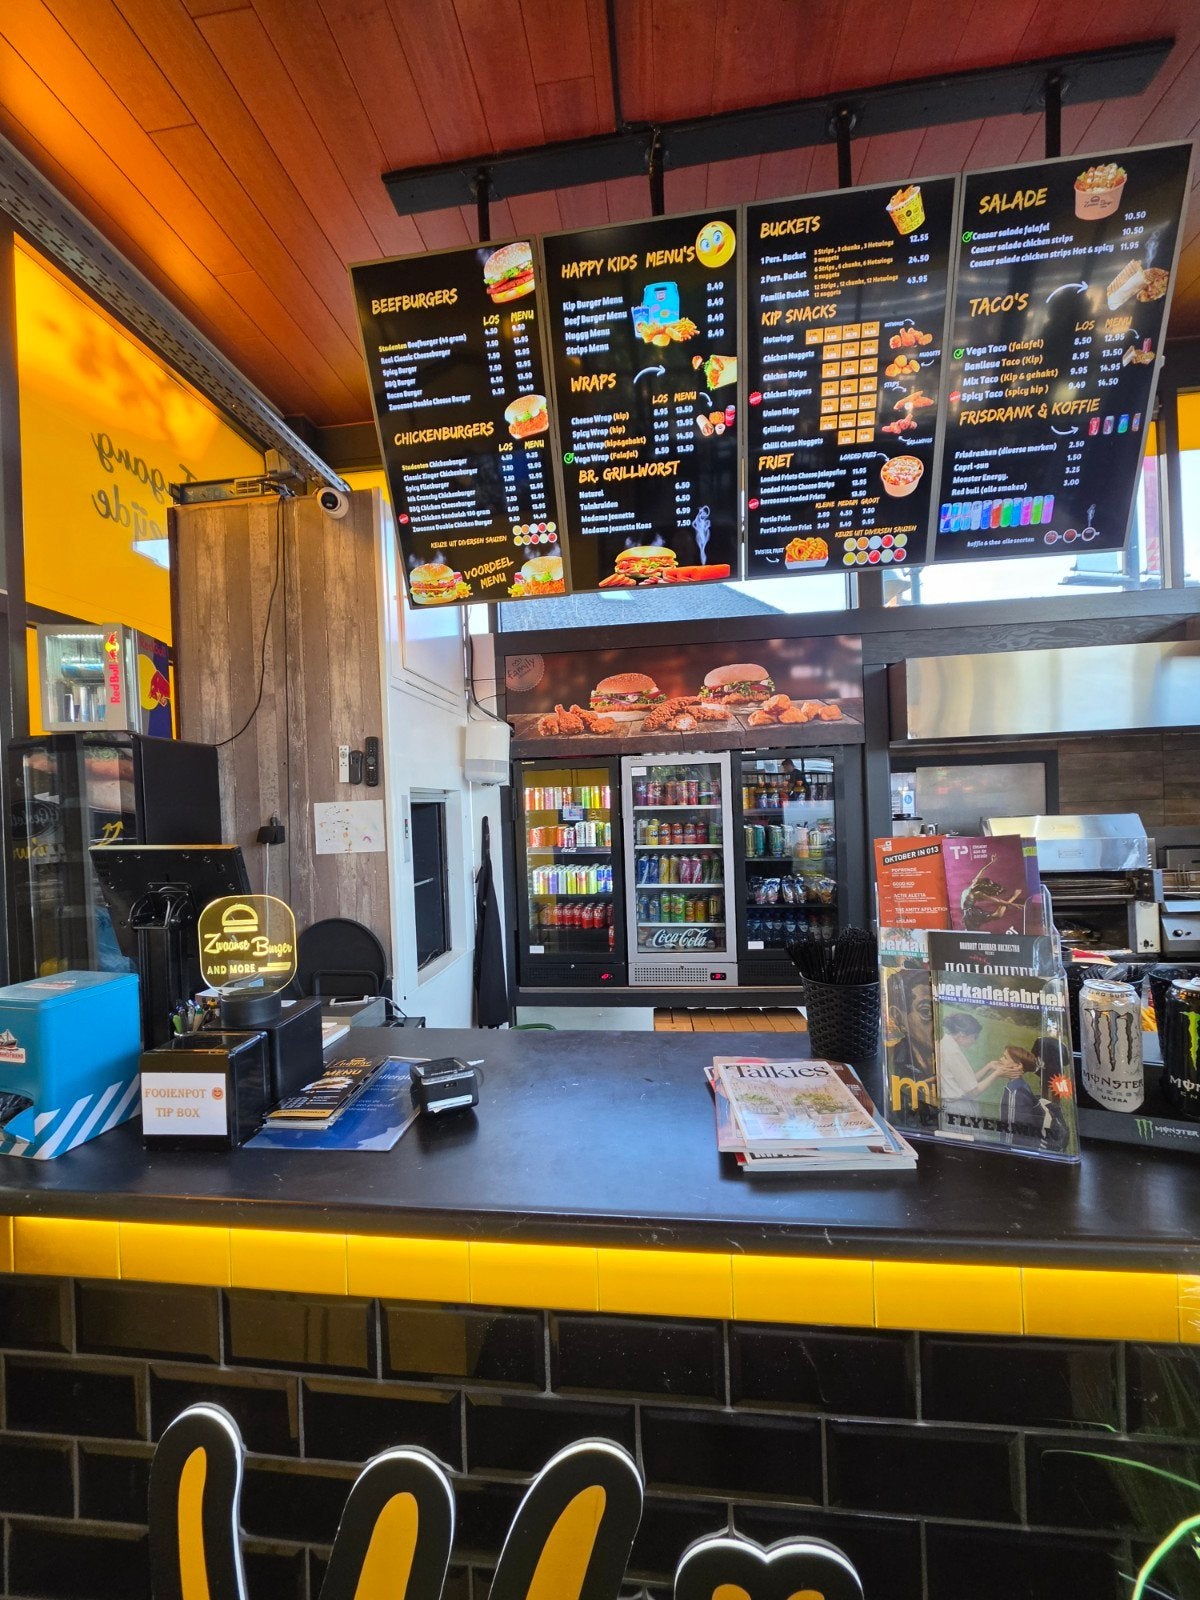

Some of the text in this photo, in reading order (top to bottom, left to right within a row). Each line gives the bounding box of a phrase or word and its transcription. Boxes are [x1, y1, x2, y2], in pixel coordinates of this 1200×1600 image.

[979, 187, 1048, 214] SALADE
[1124, 210, 1146, 220] 10.50
[760, 216, 821, 239] BUCKETS
[1051, 234, 1073, 244] strips
[1122, 226, 1143, 236] 10.50
[764, 255, 782, 264] Pers.
[782, 251, 806, 261] Bucket
[909, 233, 928, 242] 12.55
[1049, 248, 1071, 258] strips
[1072, 247, 1087, 255] Hot
[1120, 241, 1139, 250] 11.95
[561, 246, 695, 278] HAPPY KIDS MENU'S
[765, 274, 783, 283] Pers.
[783, 270, 807, 280] Bucket
[908, 254, 929, 263] 24.50
[785, 289, 809, 299] Bucket
[906, 274, 927, 284] 43.95
[371, 288, 458, 314] BEEFBURGERS
[562, 281, 723, 311] Kip Burger Menu 8.49
[969, 293, 1028, 316] TACO'S
[483, 310, 534, 326] LOS MENU
[564, 297, 724, 326] Beef Burger Menu 8.49
[761, 304, 836, 325] KIP SNACKS
[589, 328, 610, 337] Menu
[707, 312, 724, 322] 8.49
[1075, 316, 1132, 331] LOS MENU
[566, 328, 724, 355] Strips Menu 8.49
[763, 334, 794, 344] Hotwings
[966, 332, 1125, 356] Vega Taco (falafel) 8.50 12.95
[788, 350, 814, 360] Nuggets
[1001, 348, 1123, 366] Taco (Kip) 8.95 13.50
[570, 373, 616, 392] WRAPS
[787, 369, 807, 378] Strips
[962, 362, 1120, 386] Mix Taco (Kip gehakt) 9.95 14.95
[652, 391, 696, 404] LOS MENU
[787, 388, 812, 397] Dippers
[961, 391, 983, 402] Spicy
[984, 390, 1003, 398] Taco
[1004, 386, 1029, 397] (spicy
[1067, 381, 1085, 390] 9.49
[1097, 377, 1118, 386] 14.50
[593, 414, 612, 423] Wrap
[612, 411, 629, 421] (kip)
[959, 398, 1099, 425] FRISDRANK & KOFFIE
[394, 422, 493, 444] CHICKENBURGERS
[590, 428, 608, 436] Wrap
[498, 439, 544, 452] LOS MENU
[1068, 440, 1084, 448] 2.50
[590, 454, 609, 462] Wrap
[758, 453, 793, 470] FRIET
[1067, 453, 1082, 461] 1.50
[578, 460, 679, 483] BR. GRILLWORST
[674, 481, 690, 489] 6.50
[951, 487, 965, 496] Red
[1063, 478, 1079, 486] 3.00
[675, 494, 690, 502] 6.50
[675, 506, 690, 514] 6.99
[464, 557, 514, 580] VOORDEEL
[480, 573, 507, 589] MENU
[110, 664, 121, 704] Red Bull
[884, 852, 917, 864] OKTOBER
[926, 846, 939, 854] 013
[251, 936, 292, 957] Burger
[652, 928, 710, 947] Coca-Cola
[207, 963, 256, 975] AND MORE
[322, 1069, 362, 1077] MENU
[726, 1064, 830, 1079] Talkies
[1083, 1070, 1144, 1090] MONSTER
[145, 1088, 206, 1098] FOOIENPOT
[1101, 1095, 1128, 1103] ULTRA
[156, 1107, 200, 1118] TIP BOX
